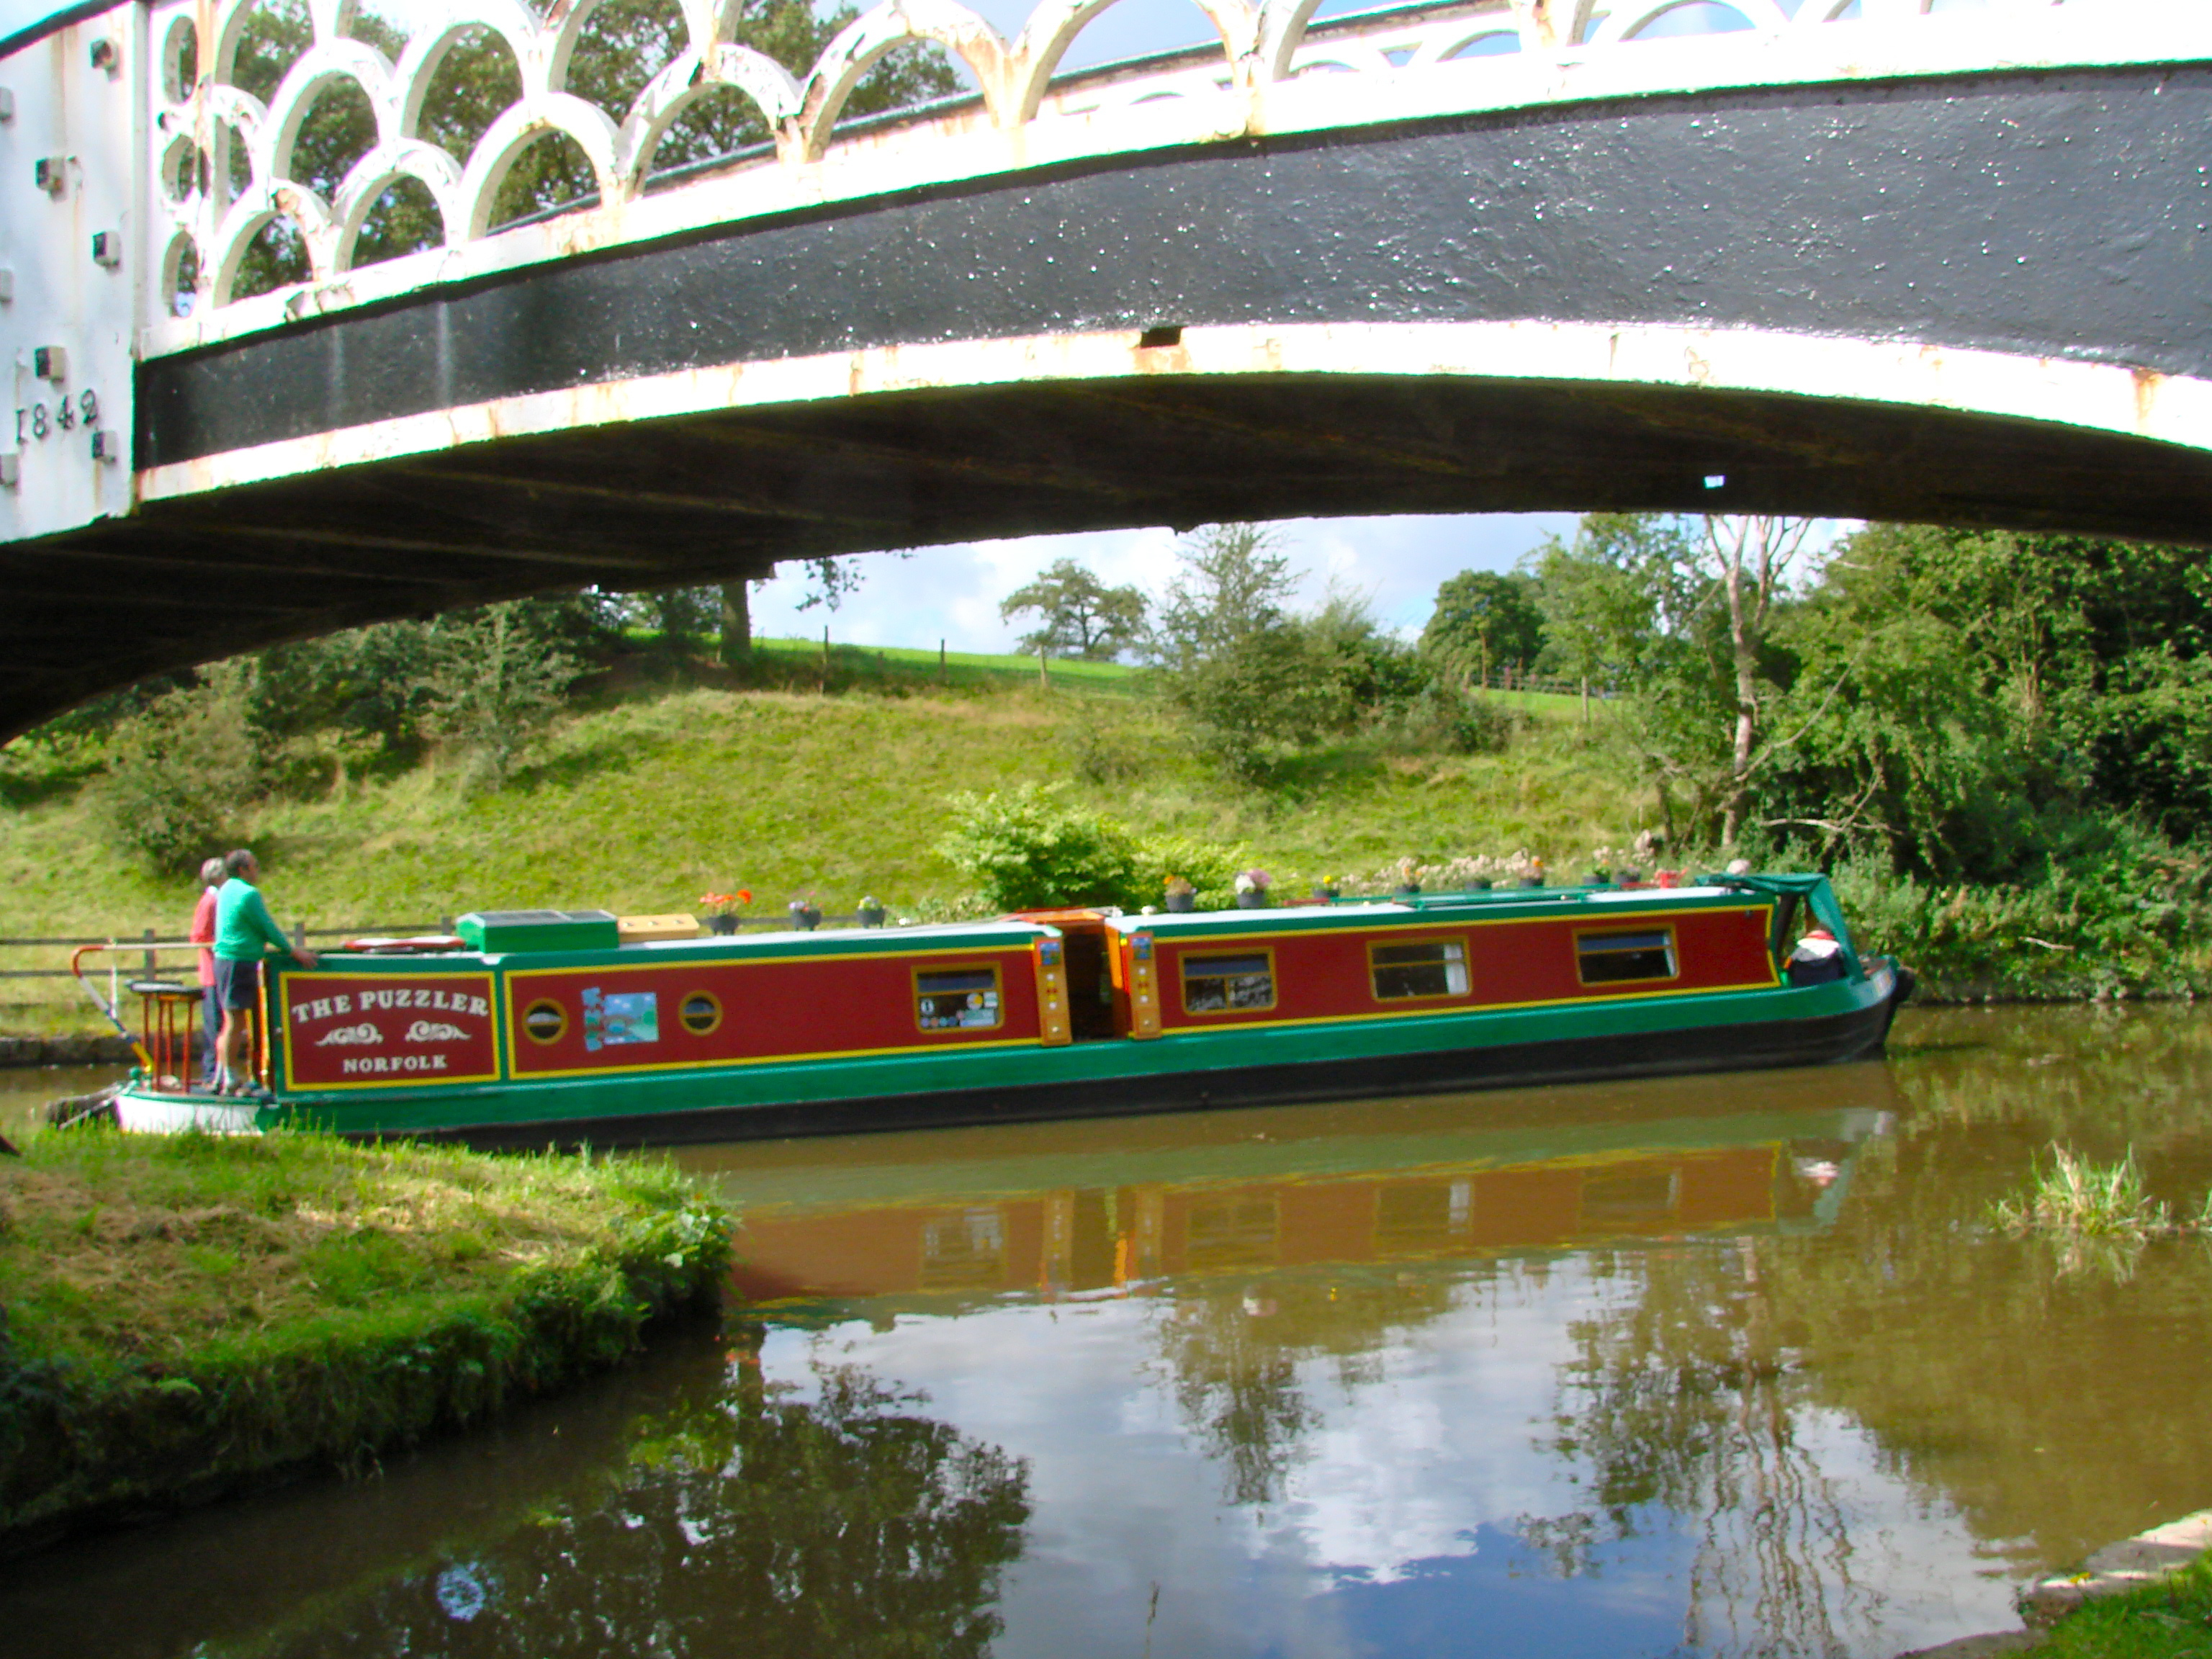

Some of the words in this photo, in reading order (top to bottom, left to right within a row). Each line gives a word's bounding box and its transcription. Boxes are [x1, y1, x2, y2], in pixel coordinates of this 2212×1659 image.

[292, 994, 352, 1023] THE
[359, 989, 488, 1017] PUZZLER
[342, 1054, 448, 1074] NORFOLK
